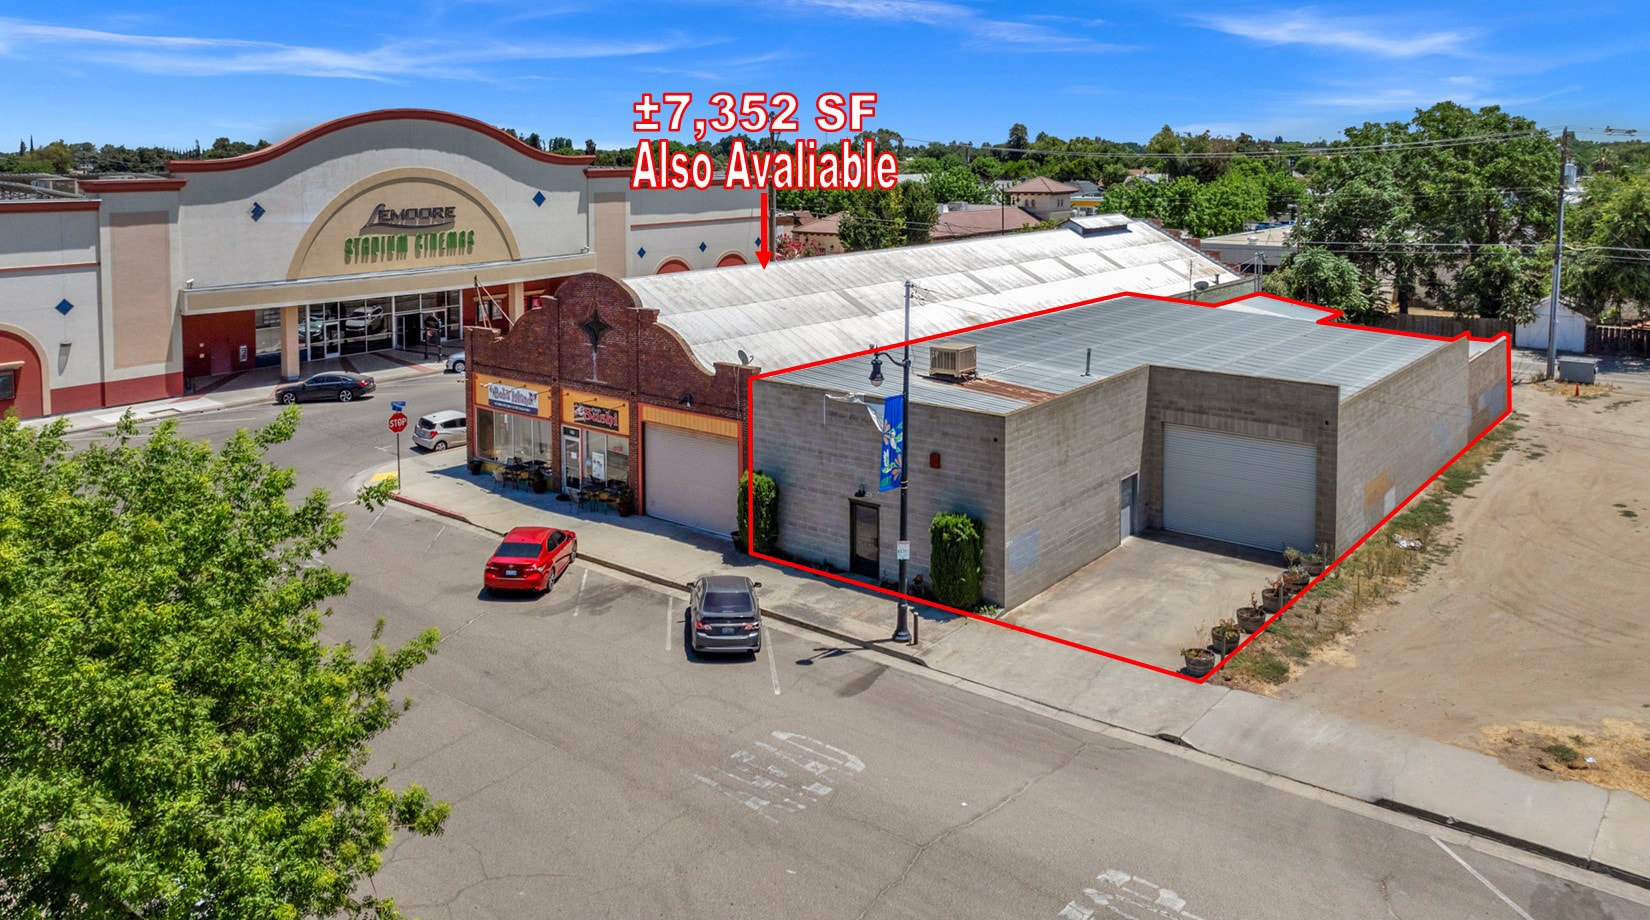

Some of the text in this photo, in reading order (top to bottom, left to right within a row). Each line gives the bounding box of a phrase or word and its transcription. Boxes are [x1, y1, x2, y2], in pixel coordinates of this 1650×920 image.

[344, 229, 475, 257] STADIUM CINEMAS
[389, 417, 407, 428] STOP
[583, 407, 618, 427] Sushi
